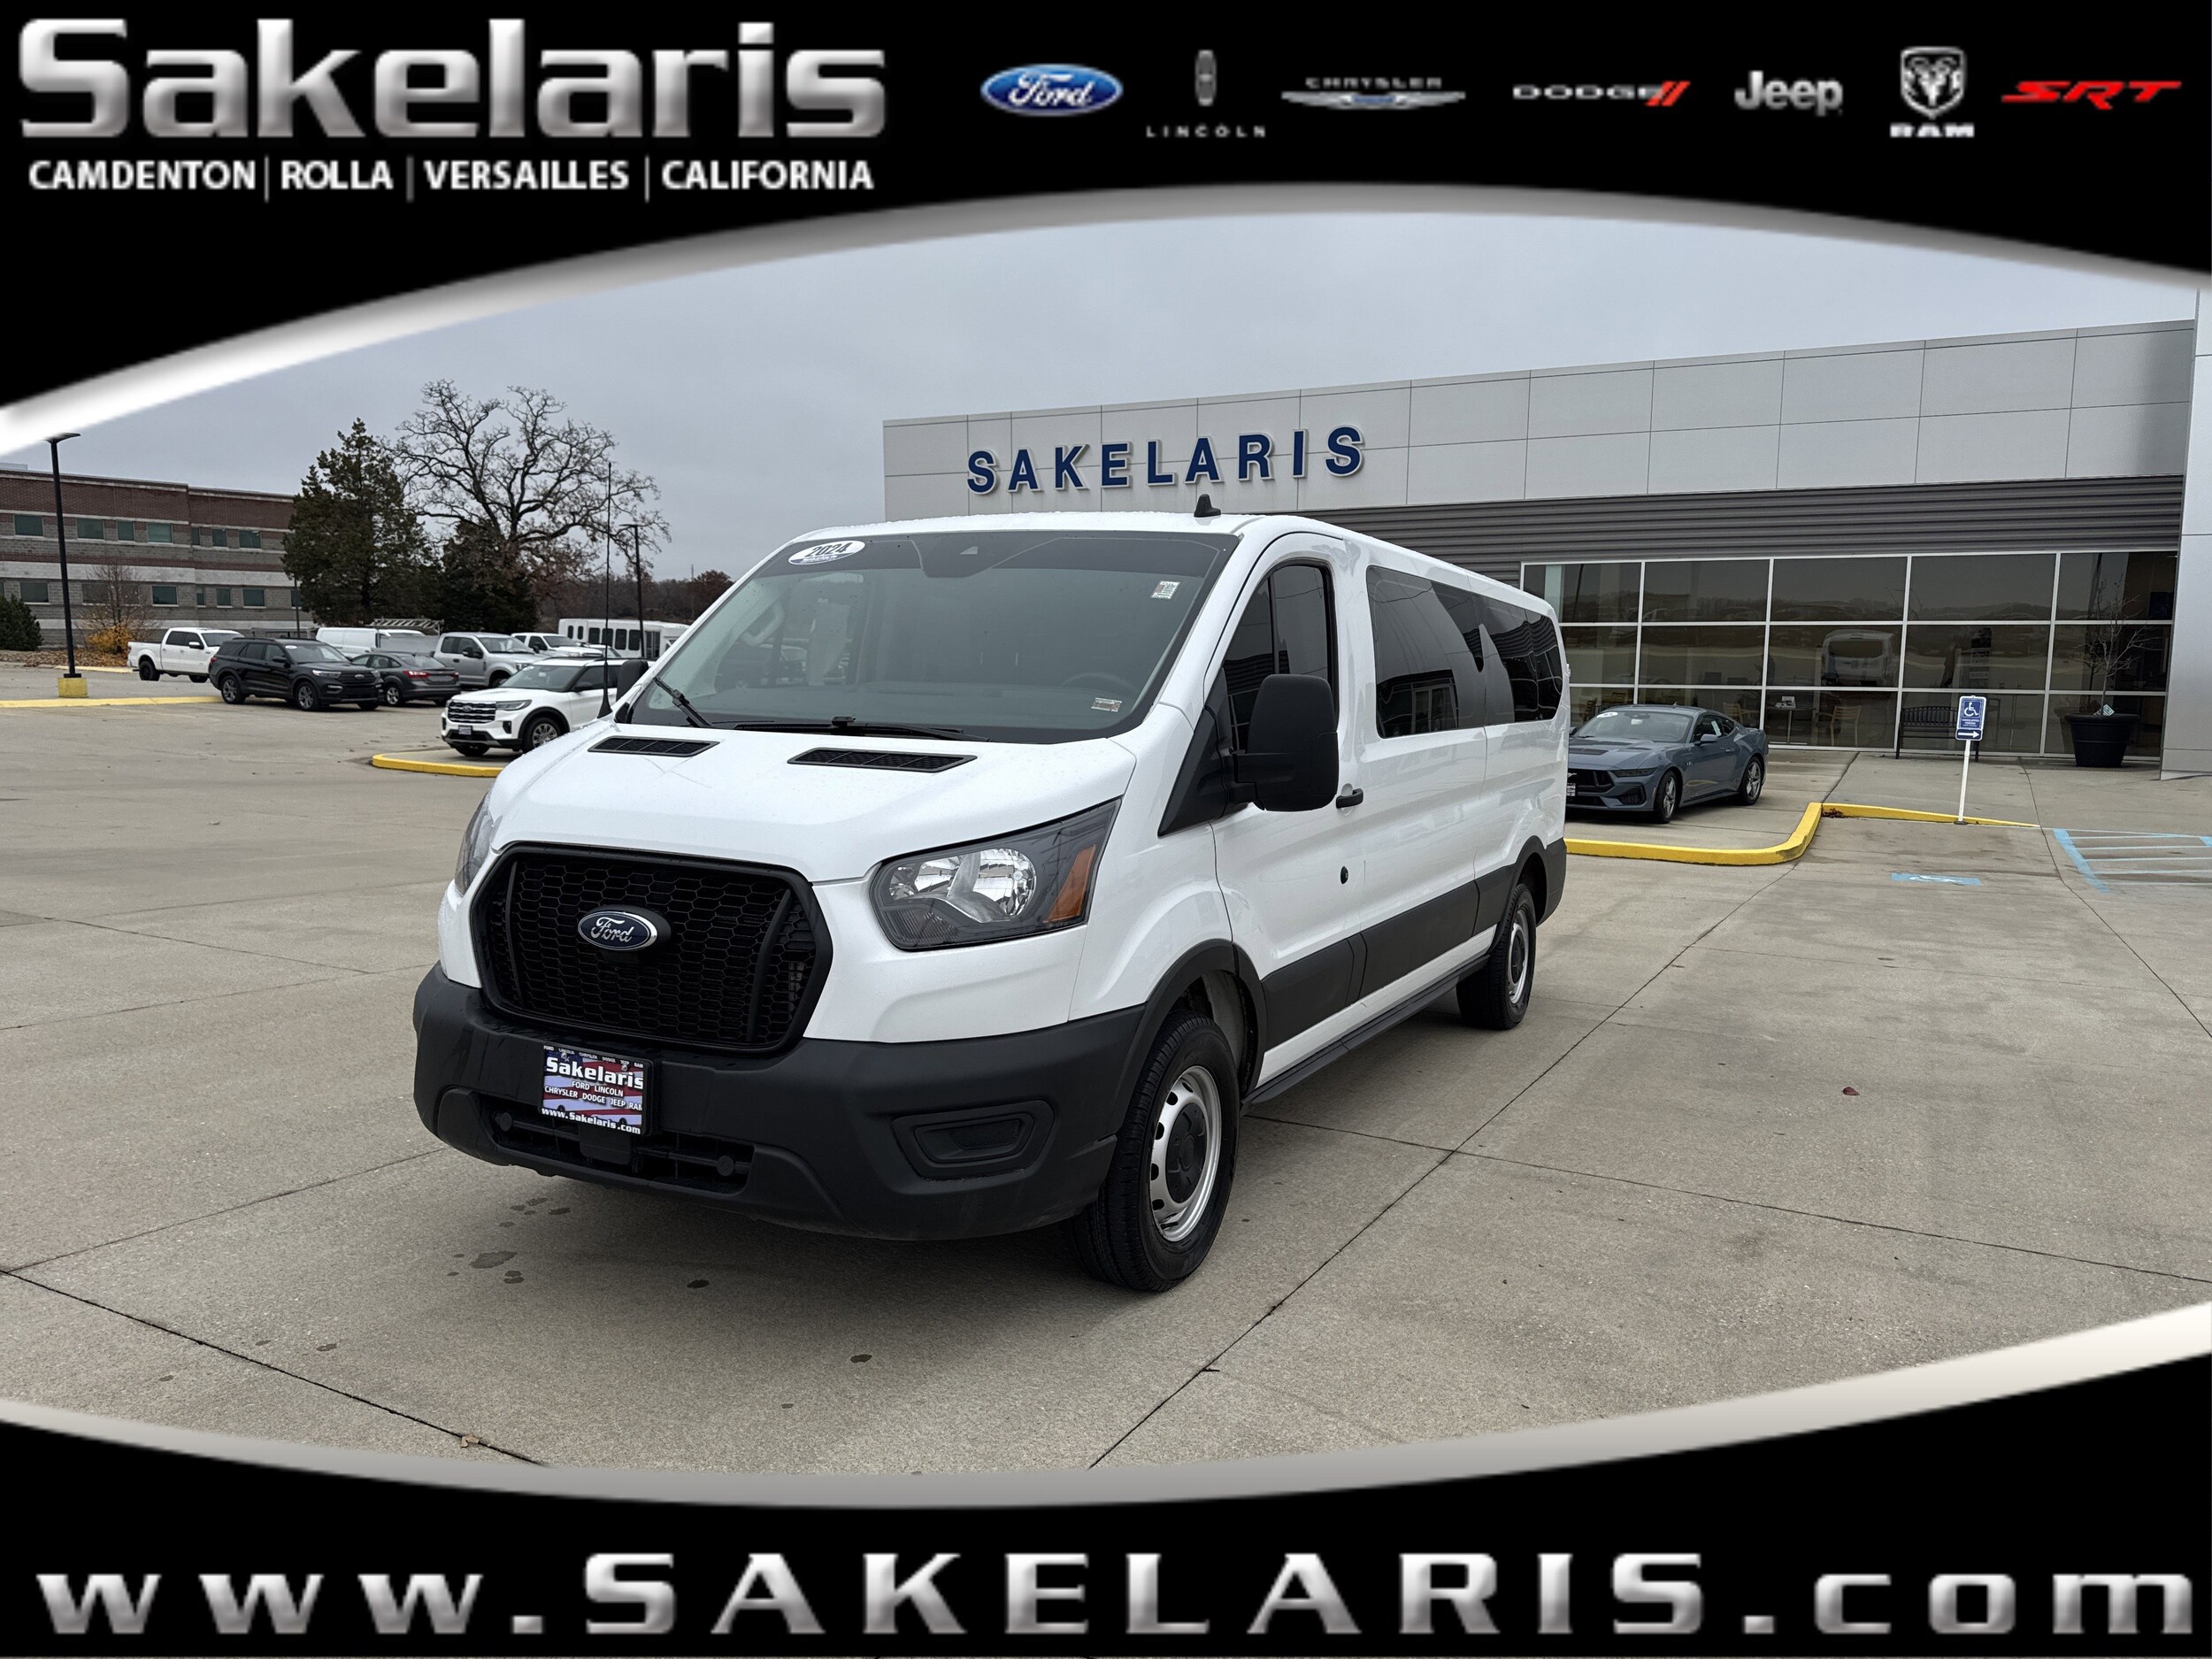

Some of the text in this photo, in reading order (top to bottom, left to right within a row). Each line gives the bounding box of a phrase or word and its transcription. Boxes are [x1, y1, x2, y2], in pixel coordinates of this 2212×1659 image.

[967, 424, 1365, 495] SAKELARIS
[804, 541, 854, 558] 2024
[590, 917, 635, 943] Ford
[546, 1056, 644, 1090] Sakelaris
[544, 1086, 578, 1098] CHRYSLER
[582, 1092, 606, 1104] DODGE
[610, 1098, 626, 1108] JEEP
[572, 1080, 624, 1097] FORD LINCOLN
[541, 1107, 641, 1135] www.Sakelaris.com
